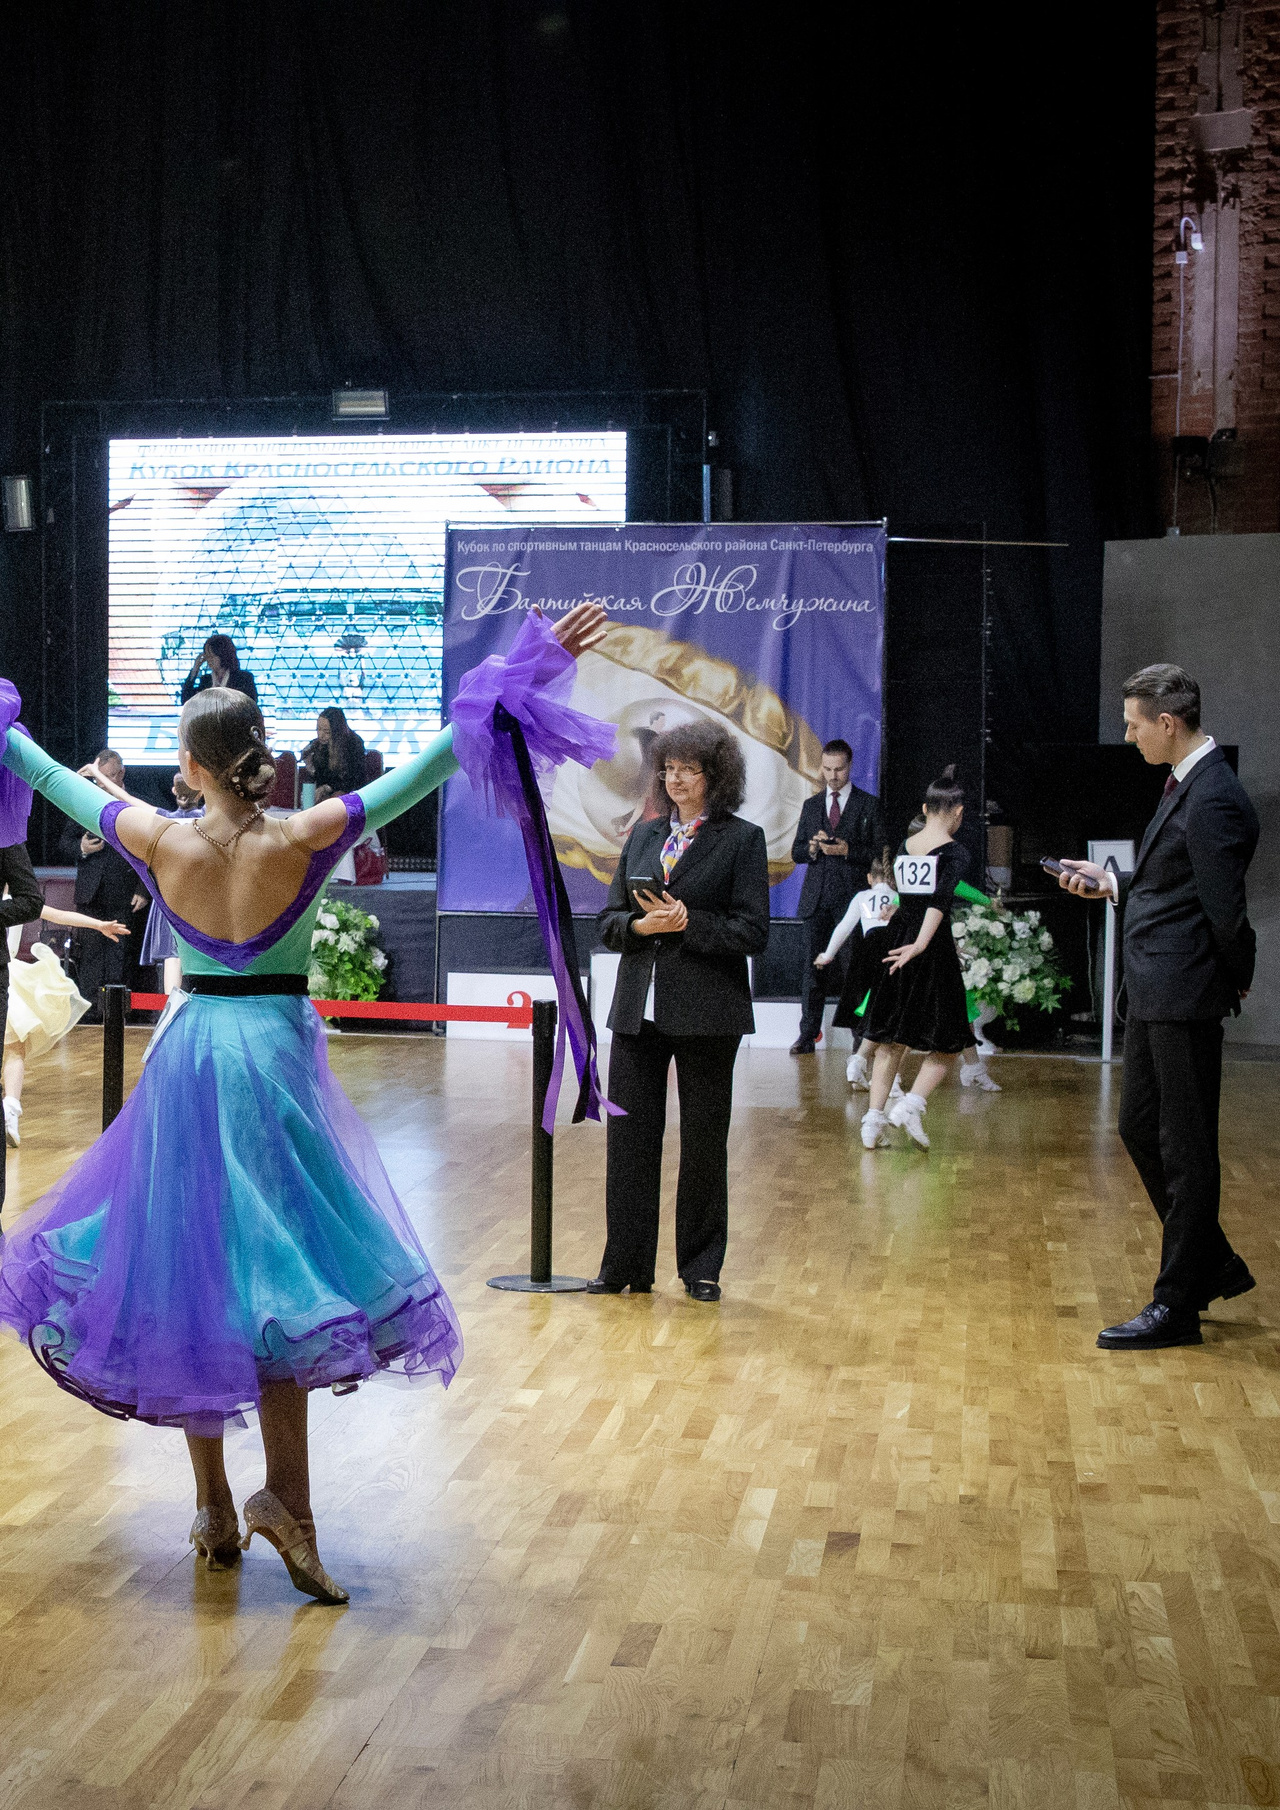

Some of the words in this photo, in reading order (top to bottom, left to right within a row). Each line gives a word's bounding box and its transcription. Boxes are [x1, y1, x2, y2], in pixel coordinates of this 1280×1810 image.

[457, 540, 490, 554] Кубок
[492, 542, 506, 552] по
[507, 541, 577, 553] спортивным
[580, 541, 622, 553] танцам
[624, 540, 723, 553] Красносельского
[724, 539, 768, 553] района
[770, 539, 874, 554] Санкт-Петербурга
[650, 562, 876, 631] Жемчужина
[898, 861, 931, 886] 132
